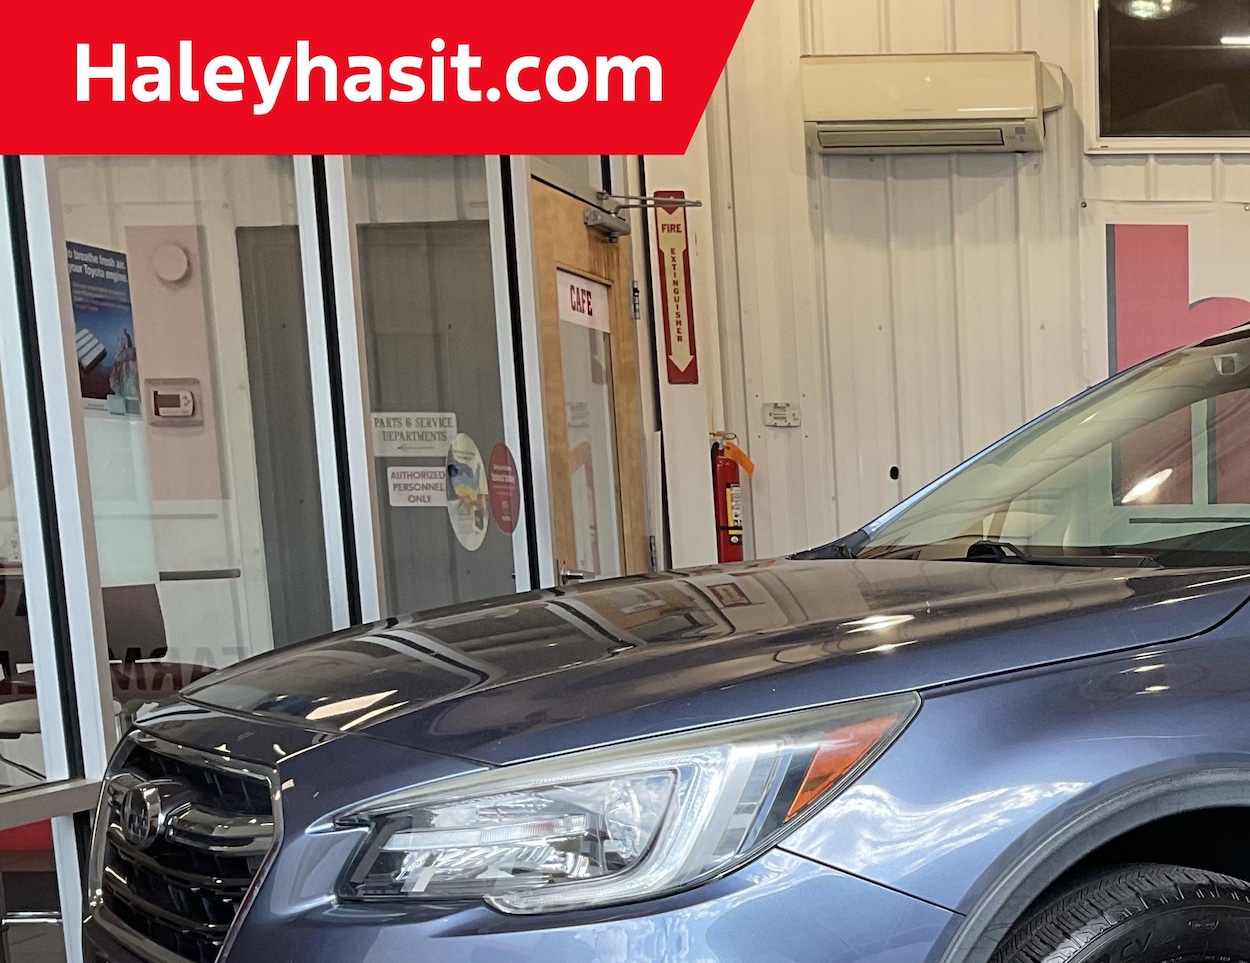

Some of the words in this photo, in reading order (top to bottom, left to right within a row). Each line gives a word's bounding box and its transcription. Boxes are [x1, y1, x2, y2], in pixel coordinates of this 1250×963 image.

[661, 223, 683, 233] FIRE
[670, 247, 683, 342] EXTINGUISHER
[570, 284, 593, 317] CAFE
[374, 417, 403, 428] PARTS
[405, 418, 412, 428] &
[415, 418, 454, 428] SERVICE
[382, 430, 448, 442] DEPARTMENTS
[390, 471, 446, 480] AUTHORIZED
[392, 482, 445, 492] PERSONNEL
[407, 494, 432, 503] ONLY
